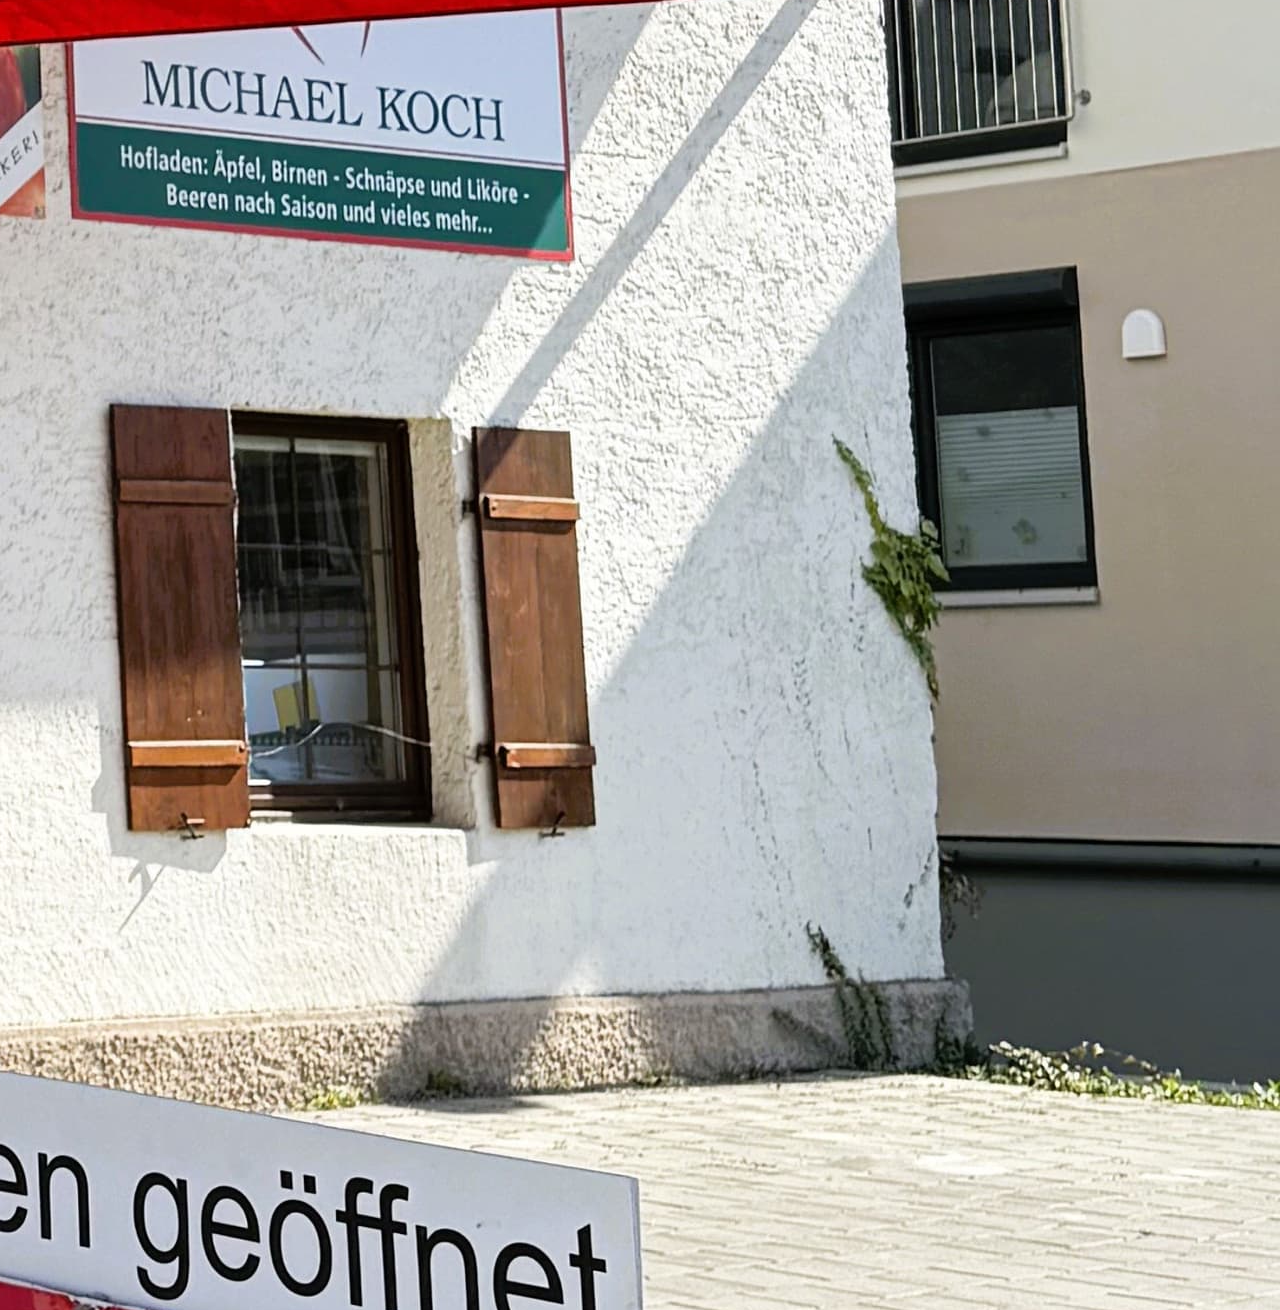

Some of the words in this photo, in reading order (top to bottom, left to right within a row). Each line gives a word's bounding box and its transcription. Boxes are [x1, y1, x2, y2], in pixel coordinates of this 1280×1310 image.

[141, 60, 364, 127] MICHAEL
[376, 87, 506, 142] KOCH
[120, 144, 210, 176] Hofladen:
[213, 148, 267, 184] Äpfel,
[272, 158, 328, 188] Birnen
[345, 165, 426, 199] Schnäpse
[430, 173, 463, 200] und
[467, 176, 519, 206] Liköre
[166, 183, 229, 212] Beeren
[234, 188, 276, 216] nach
[281, 193, 338, 222] Saison
[343, 198, 376, 226] und
[380, 203, 431, 230] vieles
[435, 208, 494, 236] mehr...
